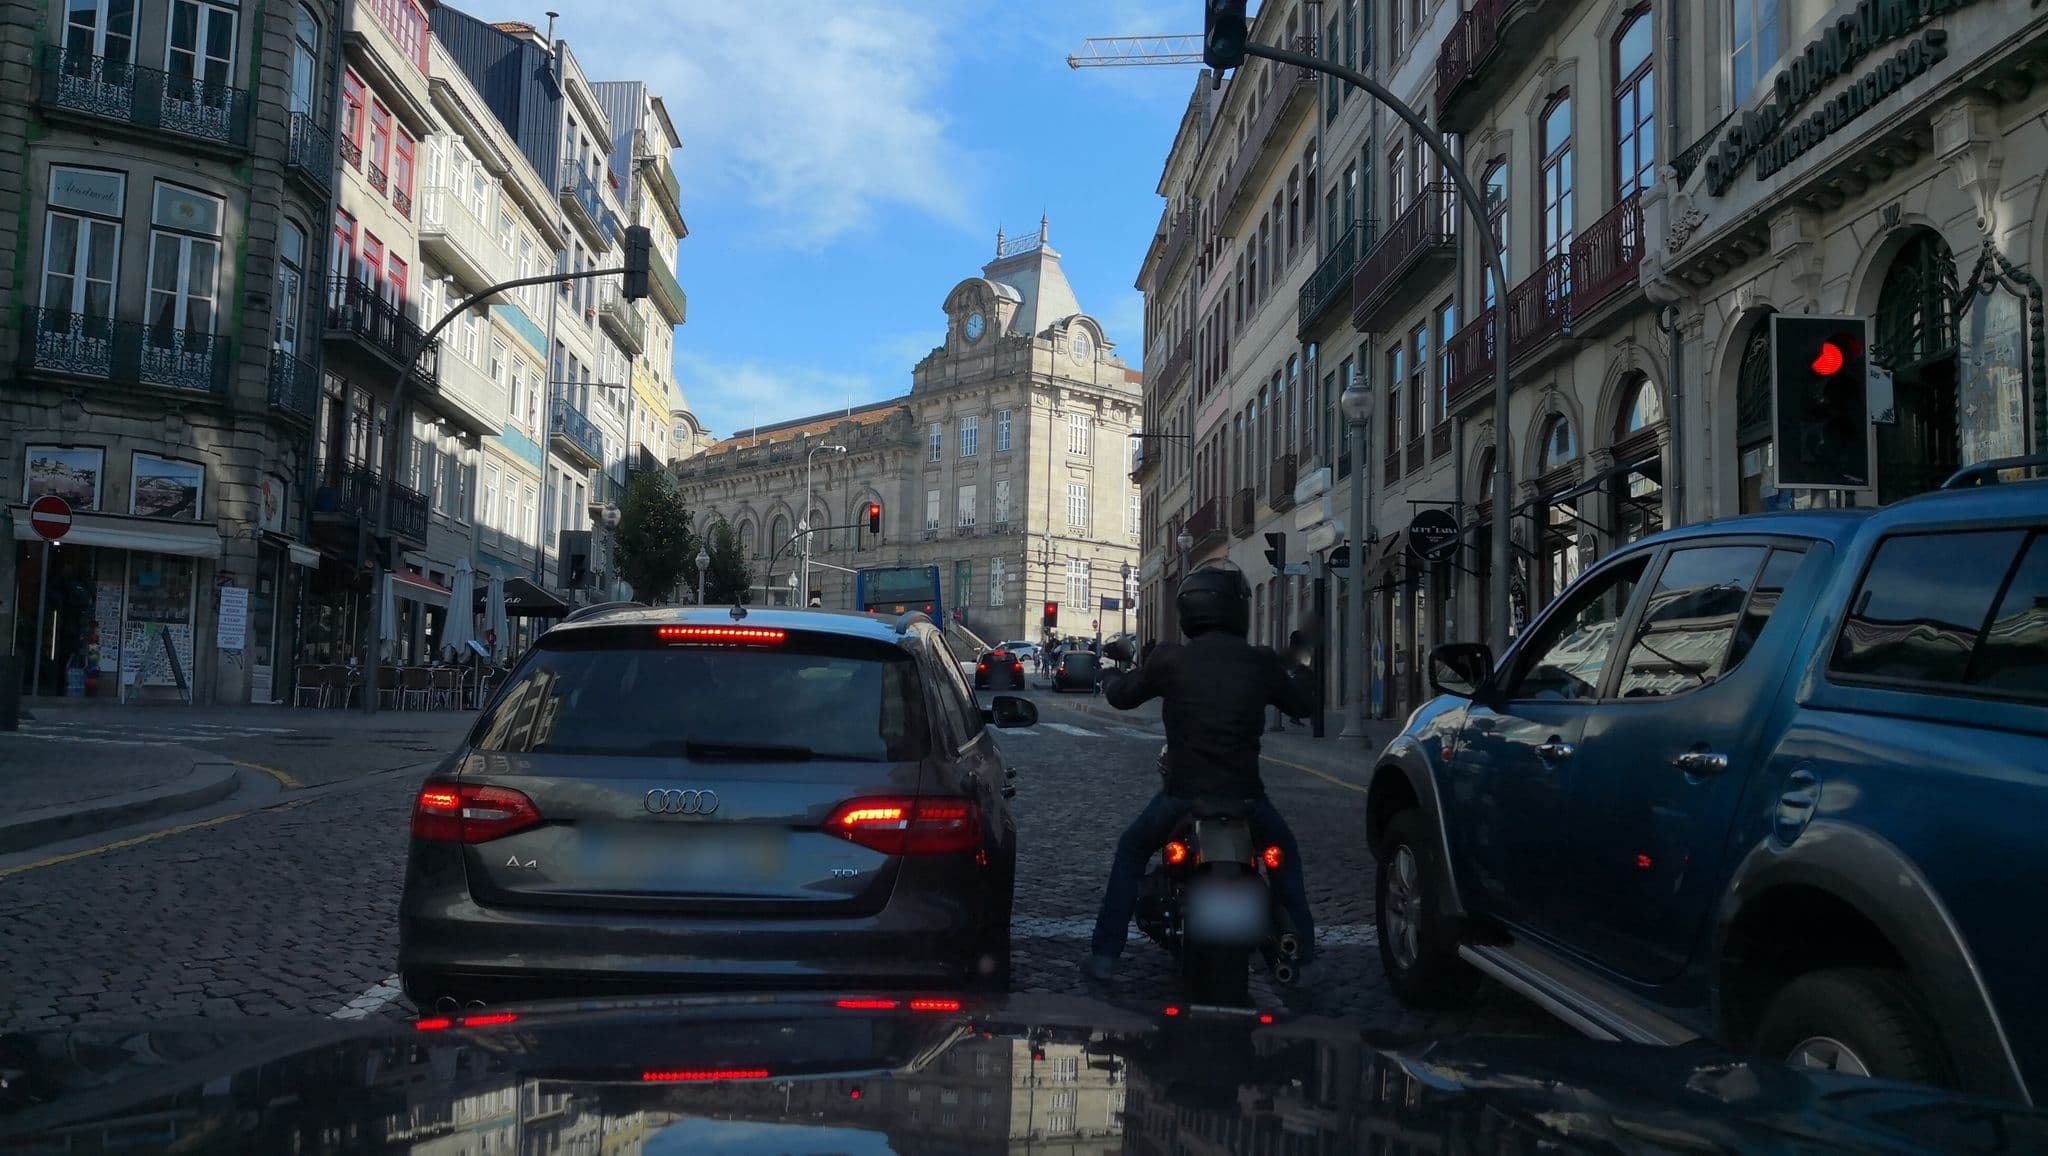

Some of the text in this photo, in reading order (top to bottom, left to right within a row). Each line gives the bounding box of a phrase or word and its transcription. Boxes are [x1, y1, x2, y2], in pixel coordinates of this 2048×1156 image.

[1756, 29, 1947, 181] ARTIGOS RELIGIOSOS
[1704, 111, 1756, 197] CASA
[505, 855, 537, 868] A4
[831, 868, 858, 877] TDI
